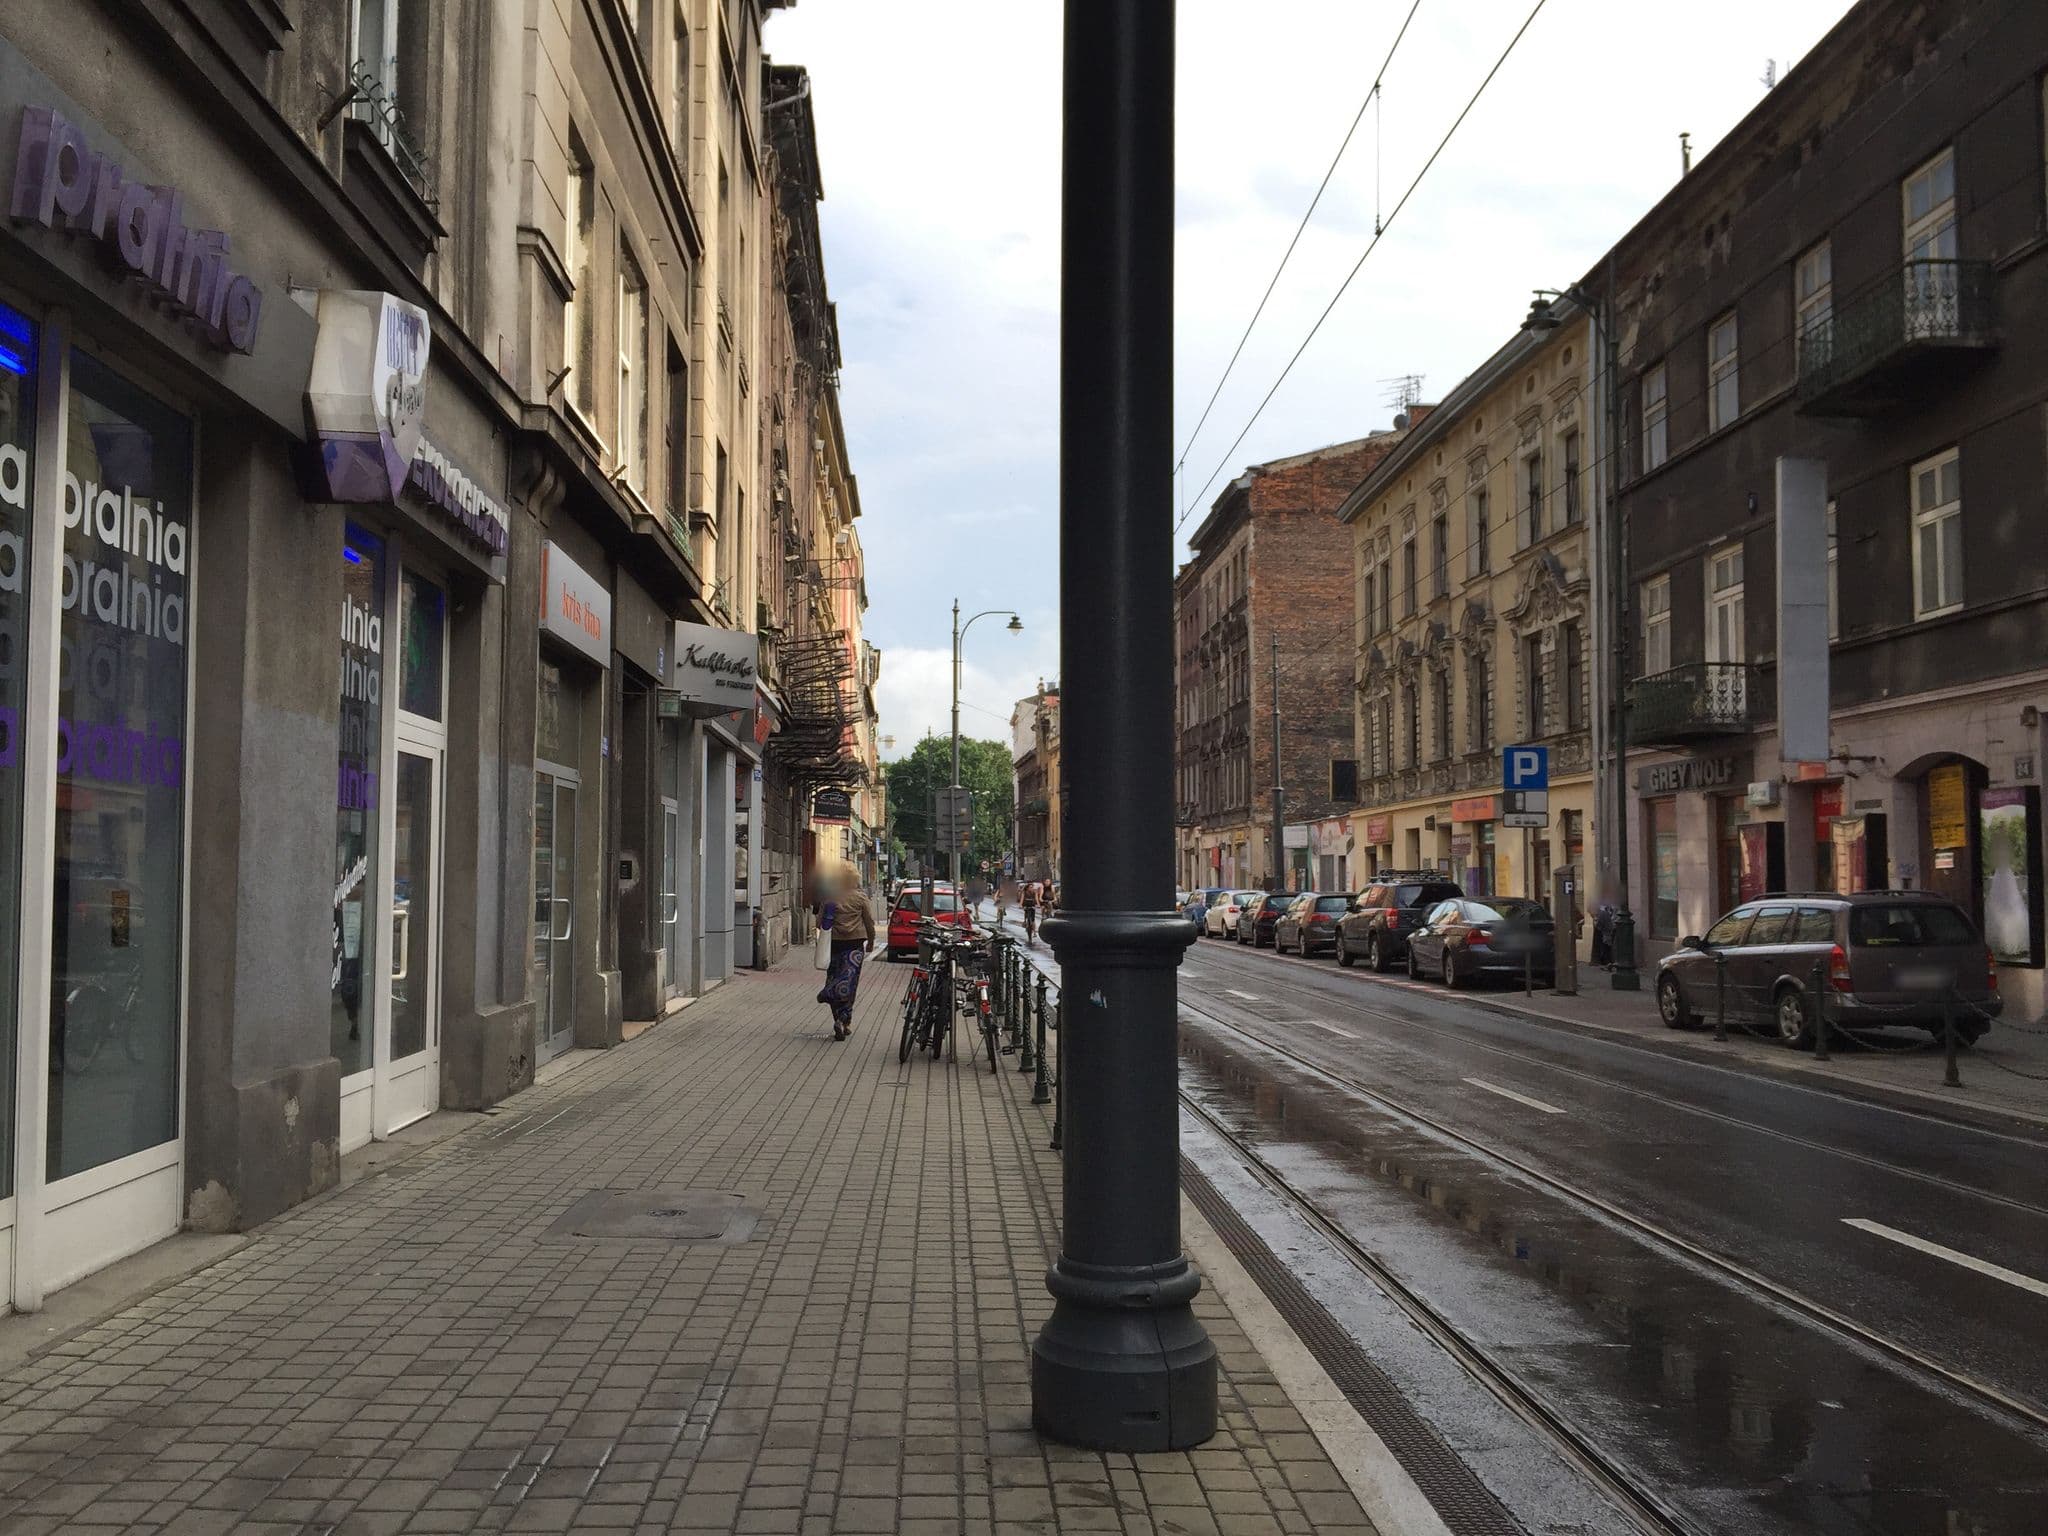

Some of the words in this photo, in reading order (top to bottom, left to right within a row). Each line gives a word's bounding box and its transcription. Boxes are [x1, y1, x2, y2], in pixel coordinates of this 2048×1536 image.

[10, 104, 262, 356] pralnia
[65, 470, 186, 575] pralnia
[62, 554, 184, 645] pralnia
[1514, 752, 1538, 784] P
[1650, 761, 1688, 790] GREY
[1688, 757, 1732, 788] WOLF
[1565, 881, 1574, 895] P
